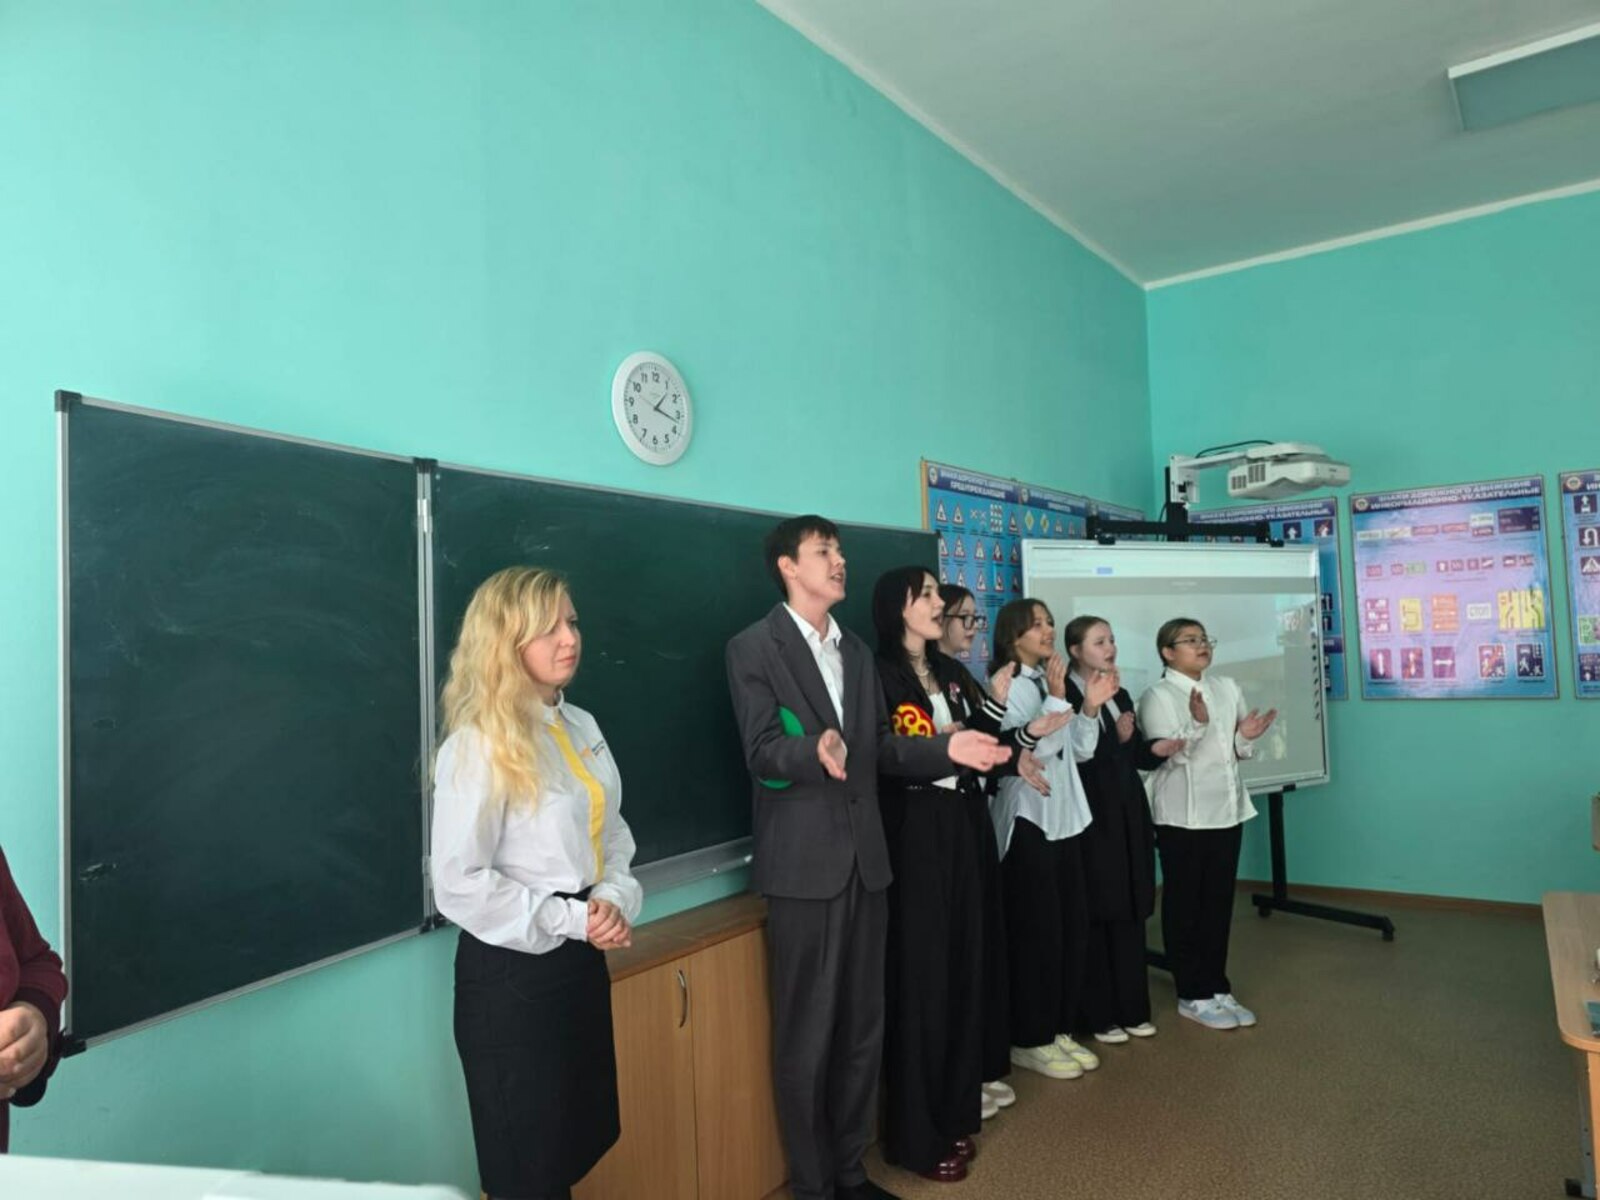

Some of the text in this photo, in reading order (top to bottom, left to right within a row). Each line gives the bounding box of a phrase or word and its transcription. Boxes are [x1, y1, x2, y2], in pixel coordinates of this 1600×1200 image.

[641, 373, 648, 383] 11
[652, 372, 660, 383] 12
[633, 382, 641, 392] 10
[665, 381, 668, 390] 1
[629, 397, 634, 406] 9
[672, 394, 677, 403] 2
[633, 414, 638, 424] 8
[676, 410, 680, 419] 3
[642, 428, 647, 437] 7
[672, 426, 677, 434] 4
[653, 436, 658, 444] 6
[664, 434, 669, 443] 5
